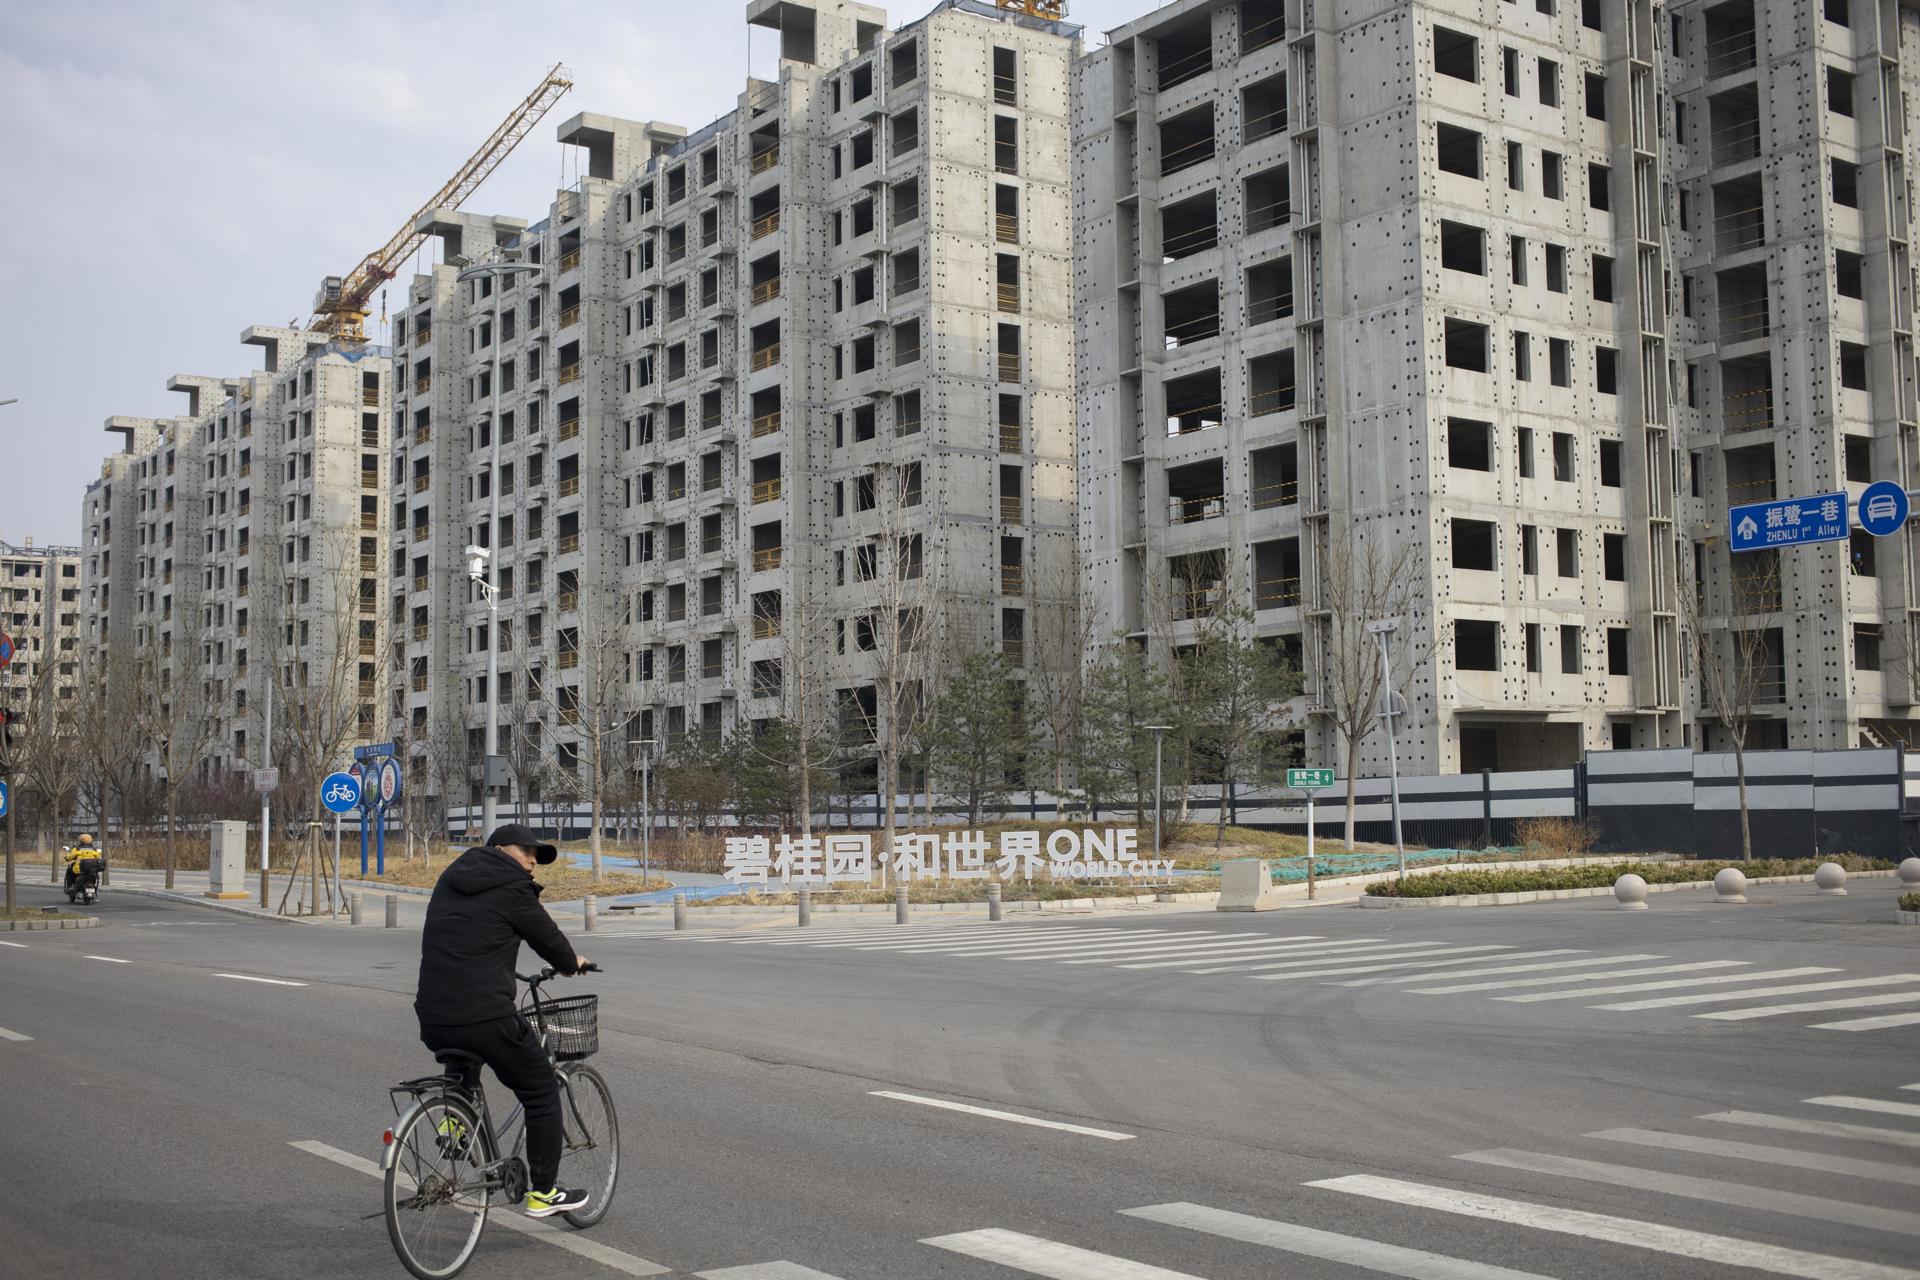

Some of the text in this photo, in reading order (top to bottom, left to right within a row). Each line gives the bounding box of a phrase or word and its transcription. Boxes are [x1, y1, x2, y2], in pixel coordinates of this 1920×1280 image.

[1766, 500, 1839, 528] 振鹭一巷
[1766, 525, 1840, 543] ZHENLU 1st Alley
[1047, 828, 1138, 862] ONE
[1049, 860, 1176, 878] WORLD CITY
